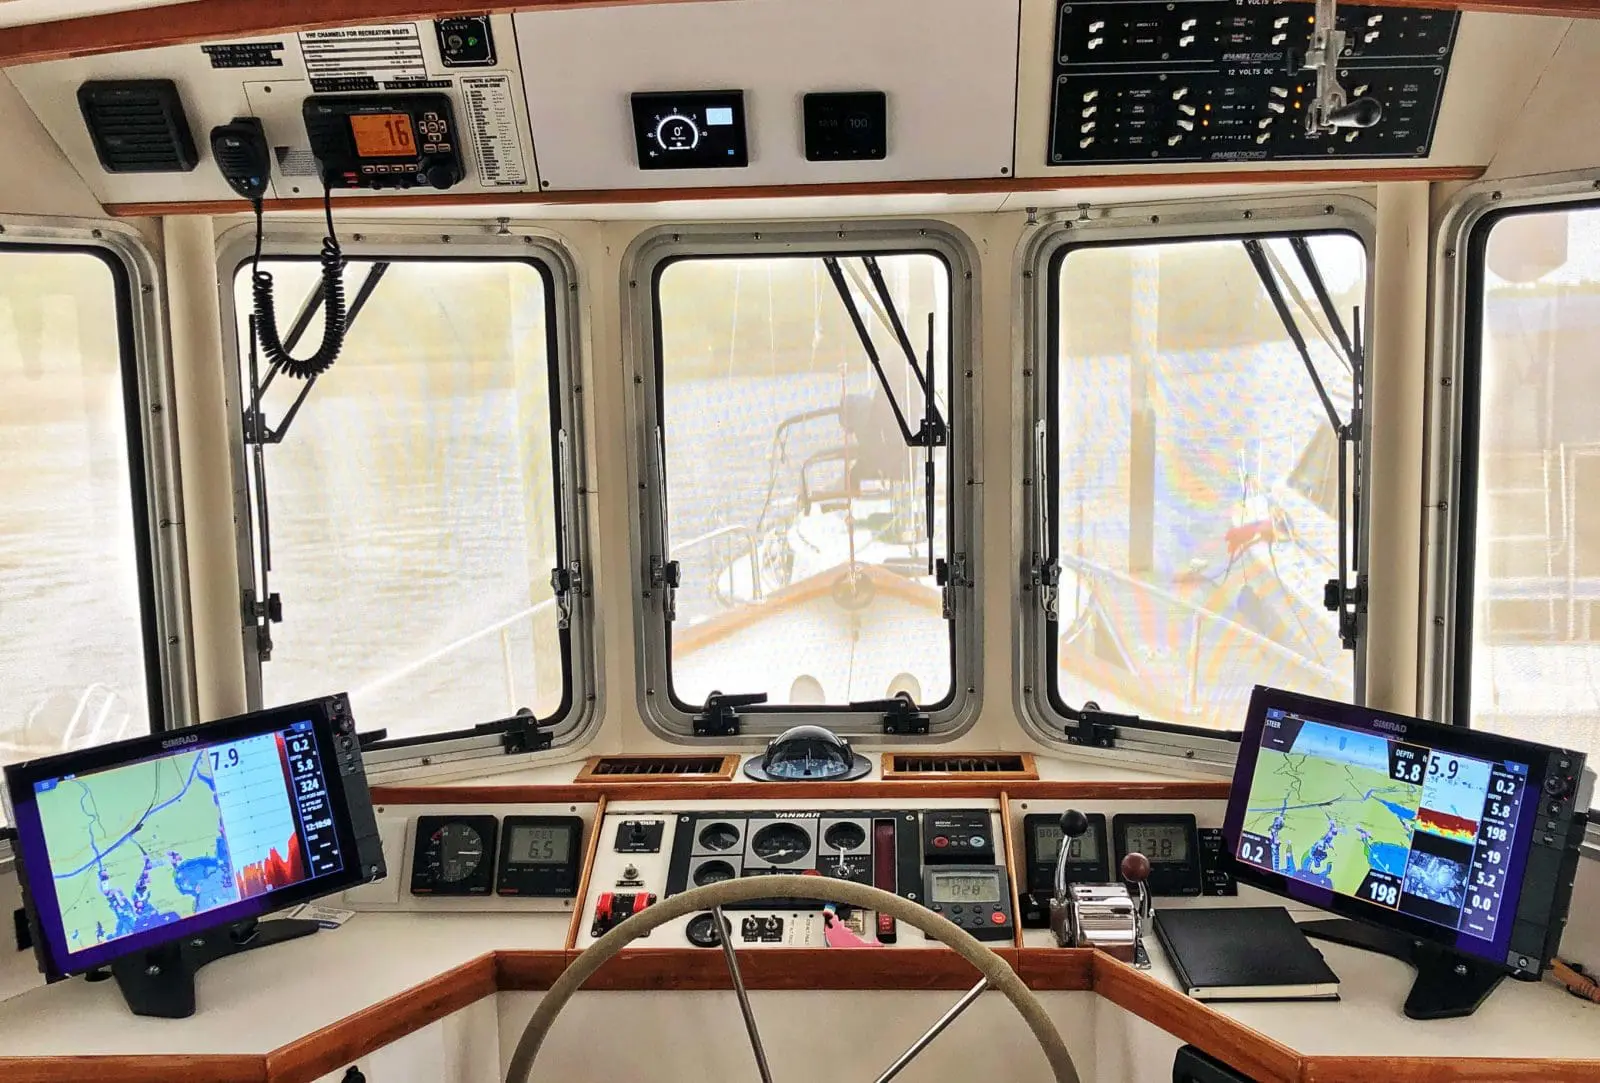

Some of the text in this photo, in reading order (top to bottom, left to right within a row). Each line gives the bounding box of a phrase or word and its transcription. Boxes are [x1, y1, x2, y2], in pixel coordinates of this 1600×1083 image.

[384, 120, 410, 146] 16
[1266, 720, 1281, 728] STEER
[1373, 719, 1407, 733] SIMRAD
[162, 734, 198, 748] SIMRAD
[293, 739, 310, 752] 0.2
[210, 748, 238, 770] 7.9
[1396, 749, 1414, 760] DEPTH
[297, 759, 314, 772] 5.8
[1395, 760, 1421, 782] 5.8
[1428, 756, 1458, 780] 5.9
[300, 778, 319, 793] 324
[1496, 780, 1515, 795] 0.2
[1491, 802, 1510, 818] 5.8
[1487, 826, 1507, 842] 198
[1242, 842, 1264, 863] 0.2
[1482, 850, 1500, 864] -19
[1477, 871, 1496, 888] 5.2
[1370, 882, 1397, 905] 198
[1472, 895, 1491, 911] 0.0
